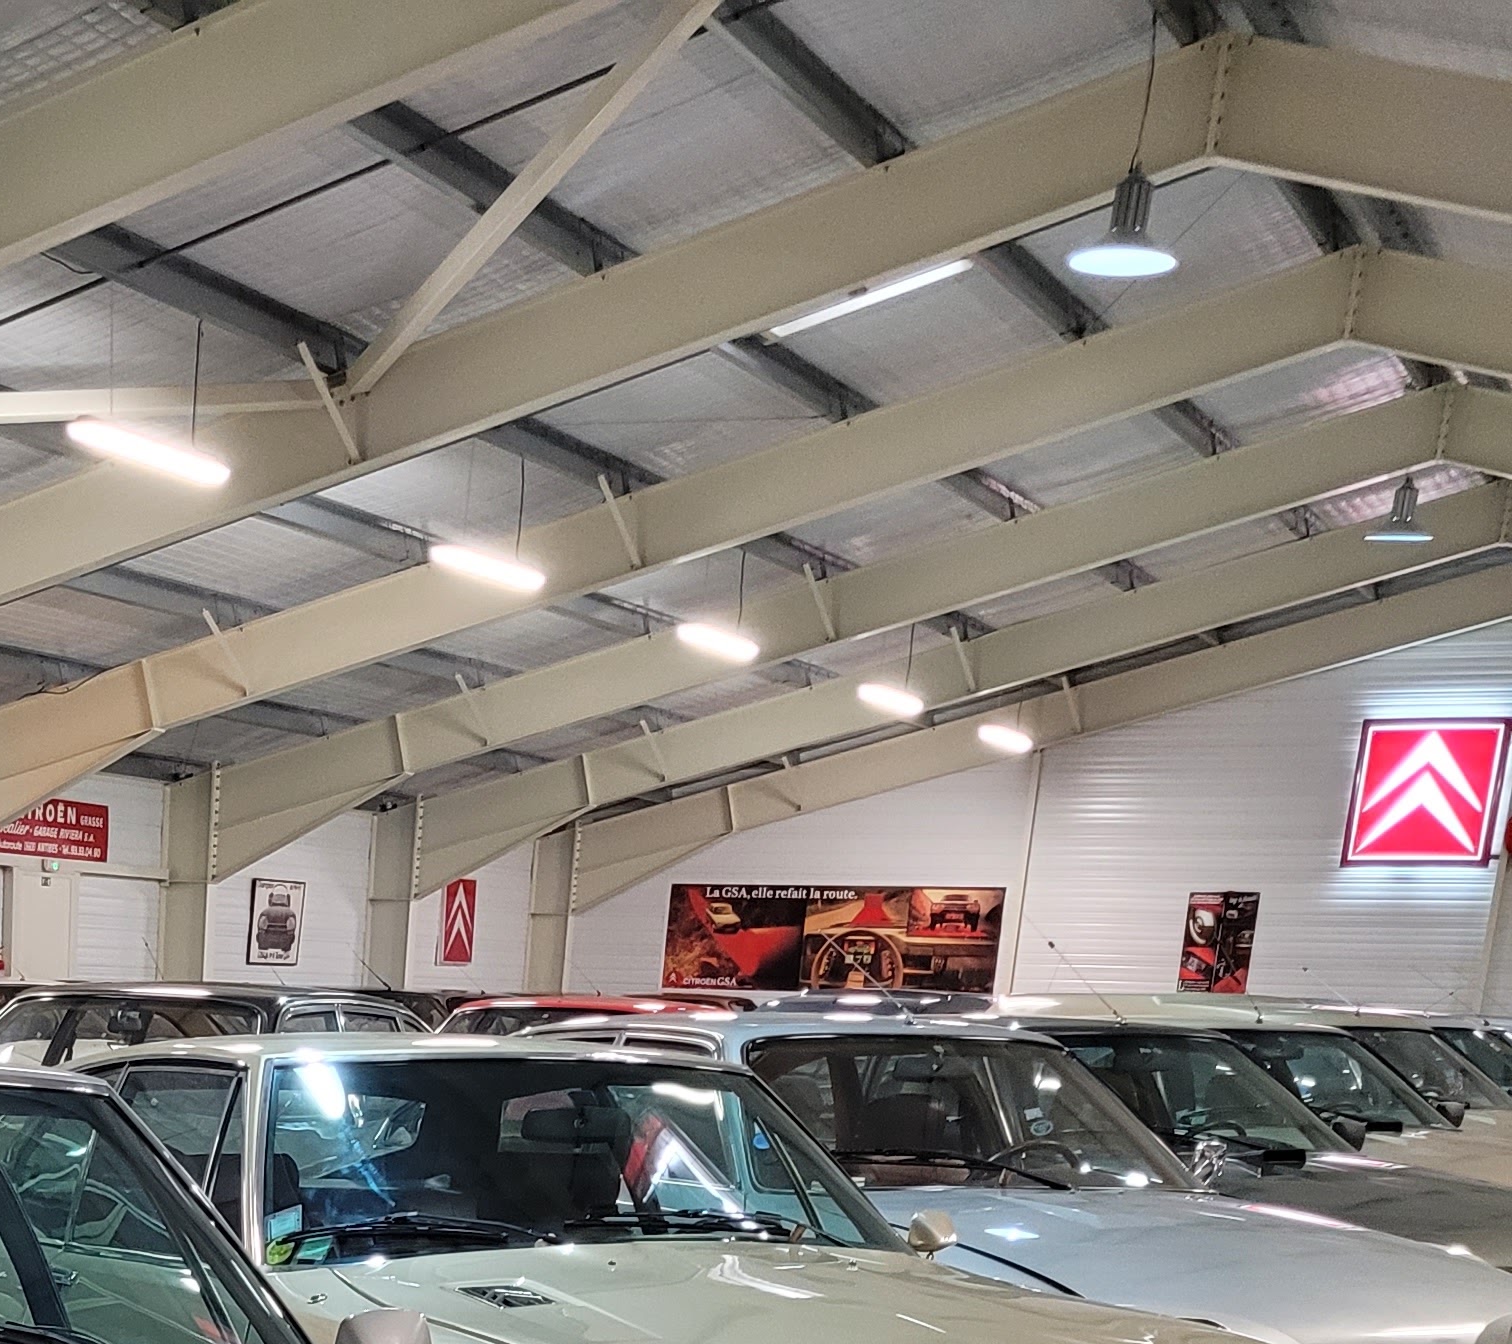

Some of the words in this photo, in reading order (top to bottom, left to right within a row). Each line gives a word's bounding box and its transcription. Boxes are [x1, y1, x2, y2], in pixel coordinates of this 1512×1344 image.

[705, 886, 720, 898] La
[721, 886, 751, 900] GSA,
[751, 887, 774, 899] elle
[775, 887, 807, 899] refait
[809, 887, 821, 900] la
[823, 889, 858, 900] route.
[717, 976, 737, 987] GSA
